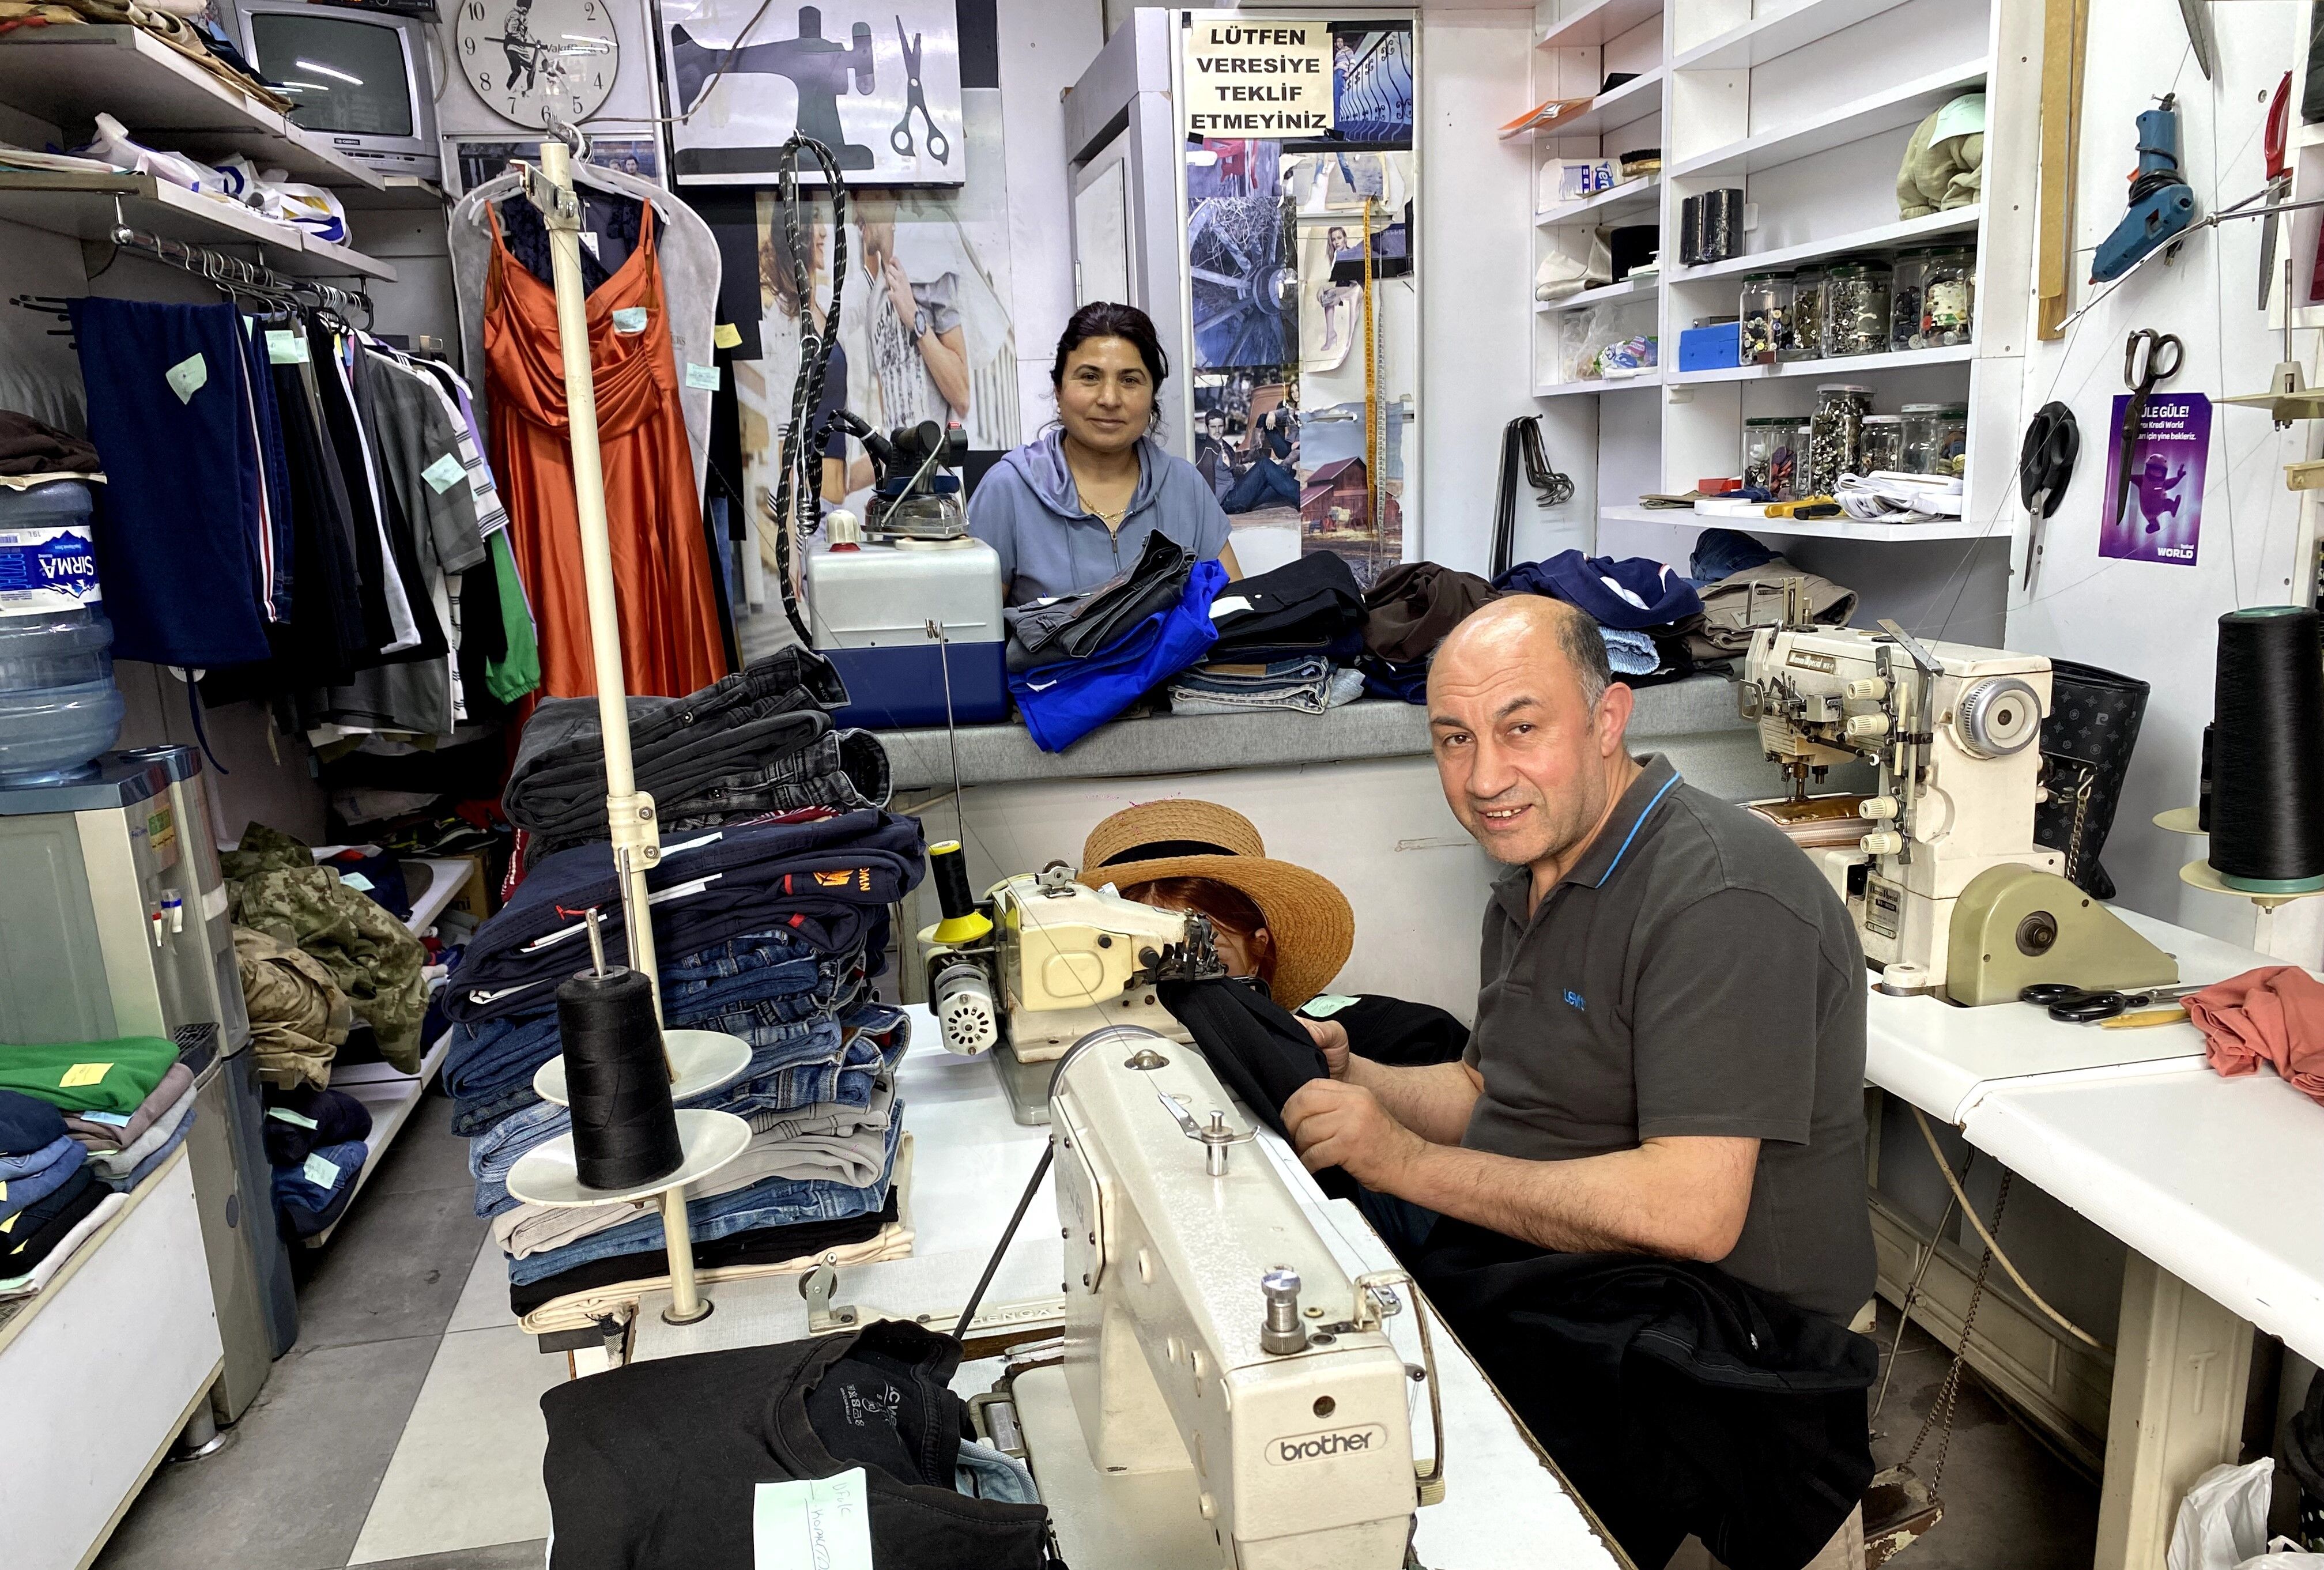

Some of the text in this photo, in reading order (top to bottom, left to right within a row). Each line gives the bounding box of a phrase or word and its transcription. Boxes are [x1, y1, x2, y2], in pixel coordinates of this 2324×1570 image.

[468, 1, 485, 21] 10
[584, 2, 596, 21] 2
[1211, 25, 1306, 45] LÜTFEN
[465, 36, 476, 55] 9
[1197, 55, 1320, 73] VERESİYE
[480, 72, 491, 91] 8
[594, 72, 604, 89] 4
[1215, 82, 1302, 101] TEKLİF
[507, 96, 516, 115] 7
[541, 105, 552, 122] 6
[572, 96, 583, 114] 5
[1191, 111, 1326, 129] ETMEYİNİZ
[2160, 403, 2190, 418] GÜLE!
[2149, 421, 2164, 429] Kredi
[2165, 421, 2185, 429] World
[2146, 432, 2157, 441] için
[2157, 432, 2171, 441] yine
[2171, 432, 2197, 440] bekleriz.
[2157, 548, 2194, 559] WORLD
[39, 556, 95, 579] SIRMA
[1281, 1432, 1372, 1461] brother
